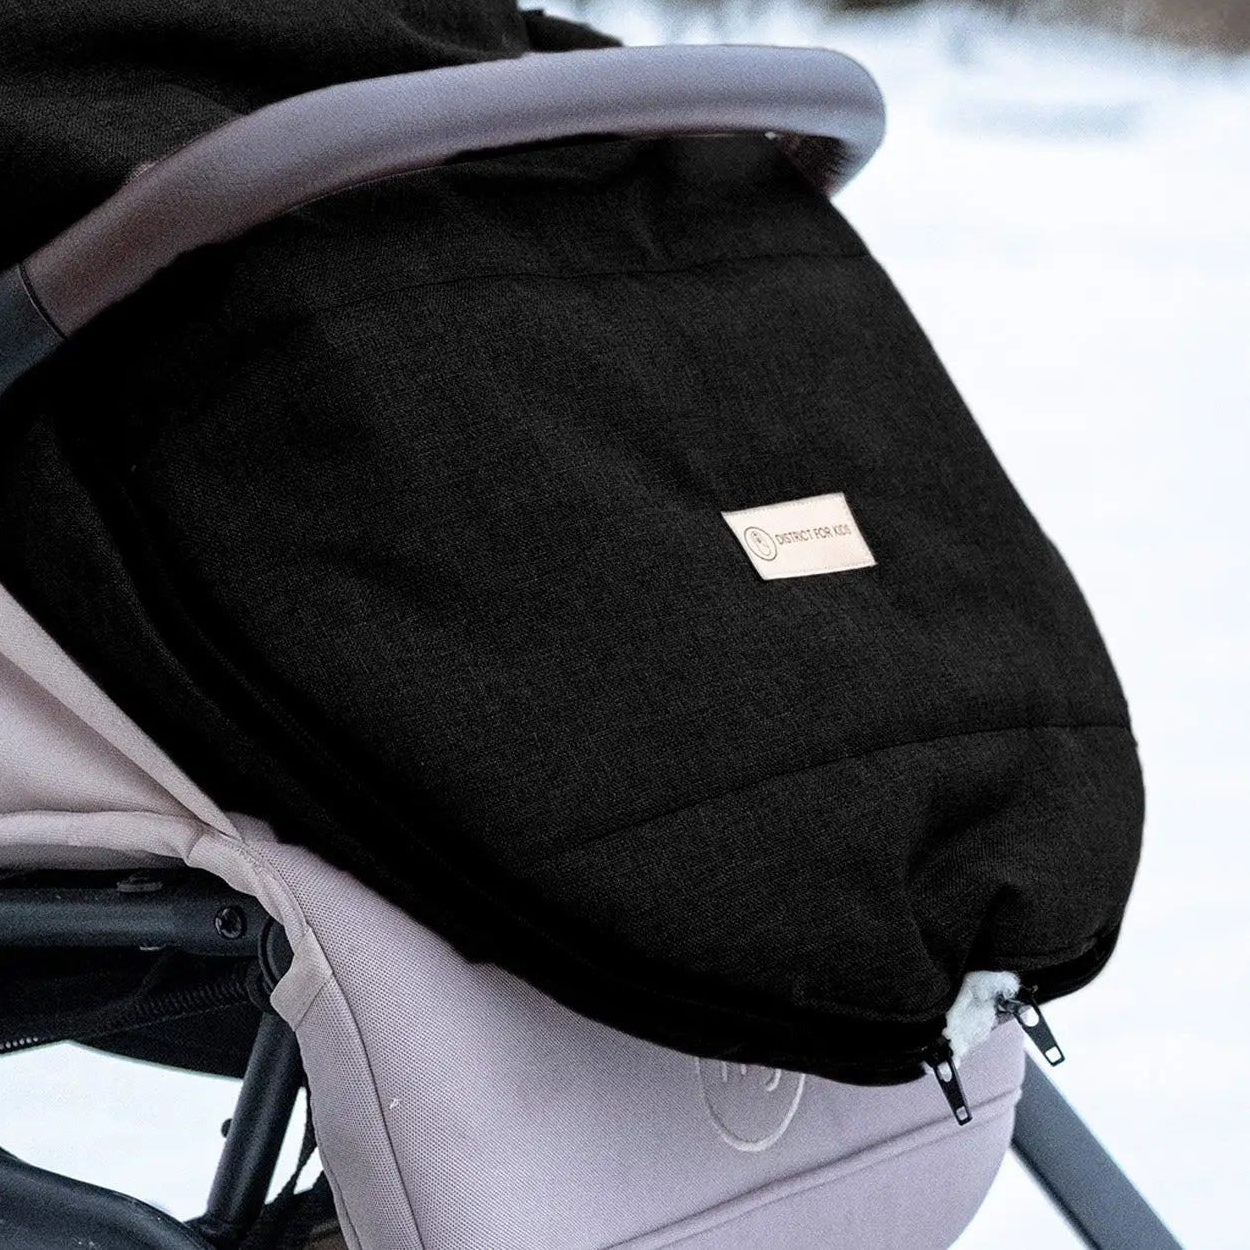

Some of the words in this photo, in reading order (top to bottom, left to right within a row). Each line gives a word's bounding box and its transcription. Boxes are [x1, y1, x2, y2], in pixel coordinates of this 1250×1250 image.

[775, 529, 813, 544] DISTRICT
[814, 527, 833, 539] FOR
[833, 524, 851, 536] KIDS
